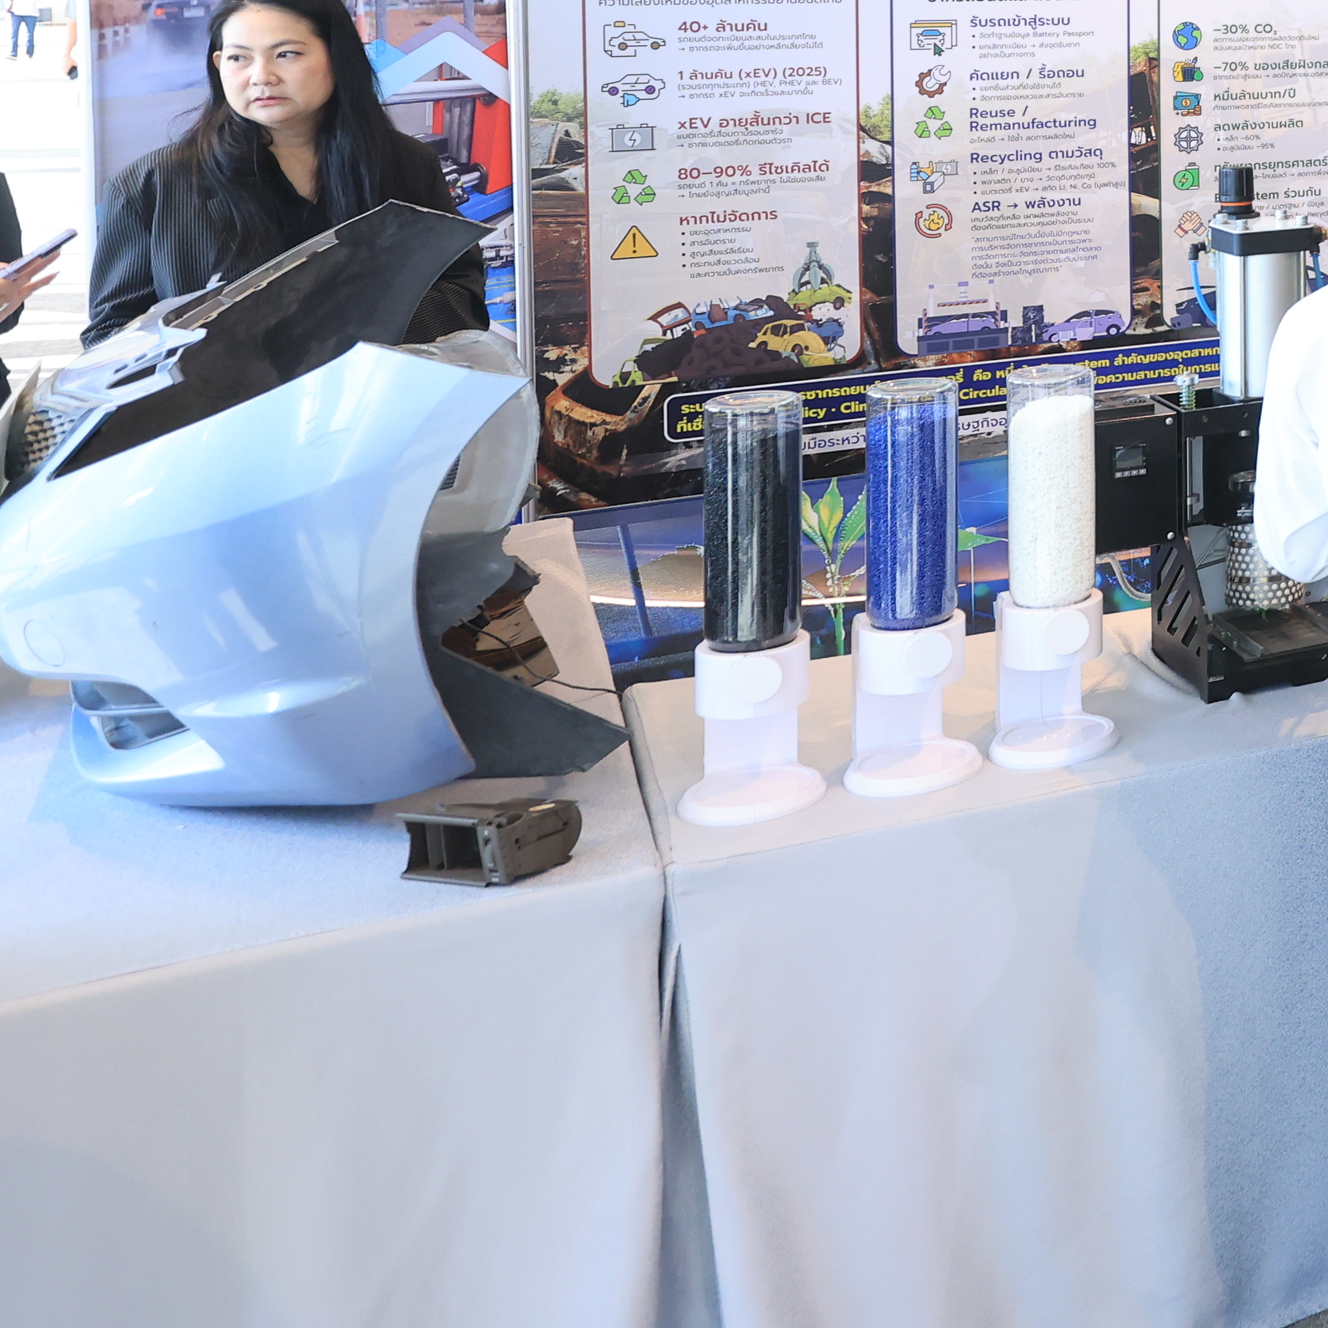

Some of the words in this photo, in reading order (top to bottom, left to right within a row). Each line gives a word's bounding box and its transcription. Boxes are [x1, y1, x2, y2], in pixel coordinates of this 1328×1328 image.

[678, 20, 709, 33] 40+
[715, 18, 768, 33] ล้านคัน
[970, 14, 1070, 30] รับรถเข้าสู่ระบบ
[1063, 30, 1094, 38] Passport
[678, 70, 684, 81] 1
[689, 68, 733, 81] ล้านคัน
[738, 68, 778, 81] (xEV)
[783, 66, 828, 78] (2025)
[970, 69, 1019, 81] คัดแยก
[1039, 63, 1084, 79] รื้อถอน
[779, 79, 802, 87] PHEV
[822, 78, 842, 86] BEV)
[1213, 87, 1296, 101] หมื่นล้านบาท/ปี
[970, 107, 1016, 118] Reuse
[677, 117, 711, 130] xEV
[719, 111, 799, 130] อายุสั้นกว่า
[806, 112, 832, 124] ICE
[970, 116, 1097, 132] Remanufacturing
[1214, 118, 1304, 132] ลดพลังงานผลิต
[970, 150, 1042, 164] Recycling
[1049, 146, 1103, 161] ตามวัสดุ
[758, 160, 830, 176] รีไซเคิลได้
[1283, 187, 1322, 199] ร่วมกัน
[971, 200, 1001, 213] ASR
[1025, 196, 1081, 209] พลังงาน
[679, 210, 778, 226] หากไม่จัดการ
[1114, 347, 1220, 367] สำคัญของอุตสาหก
[960, 387, 1008, 402] Circula
